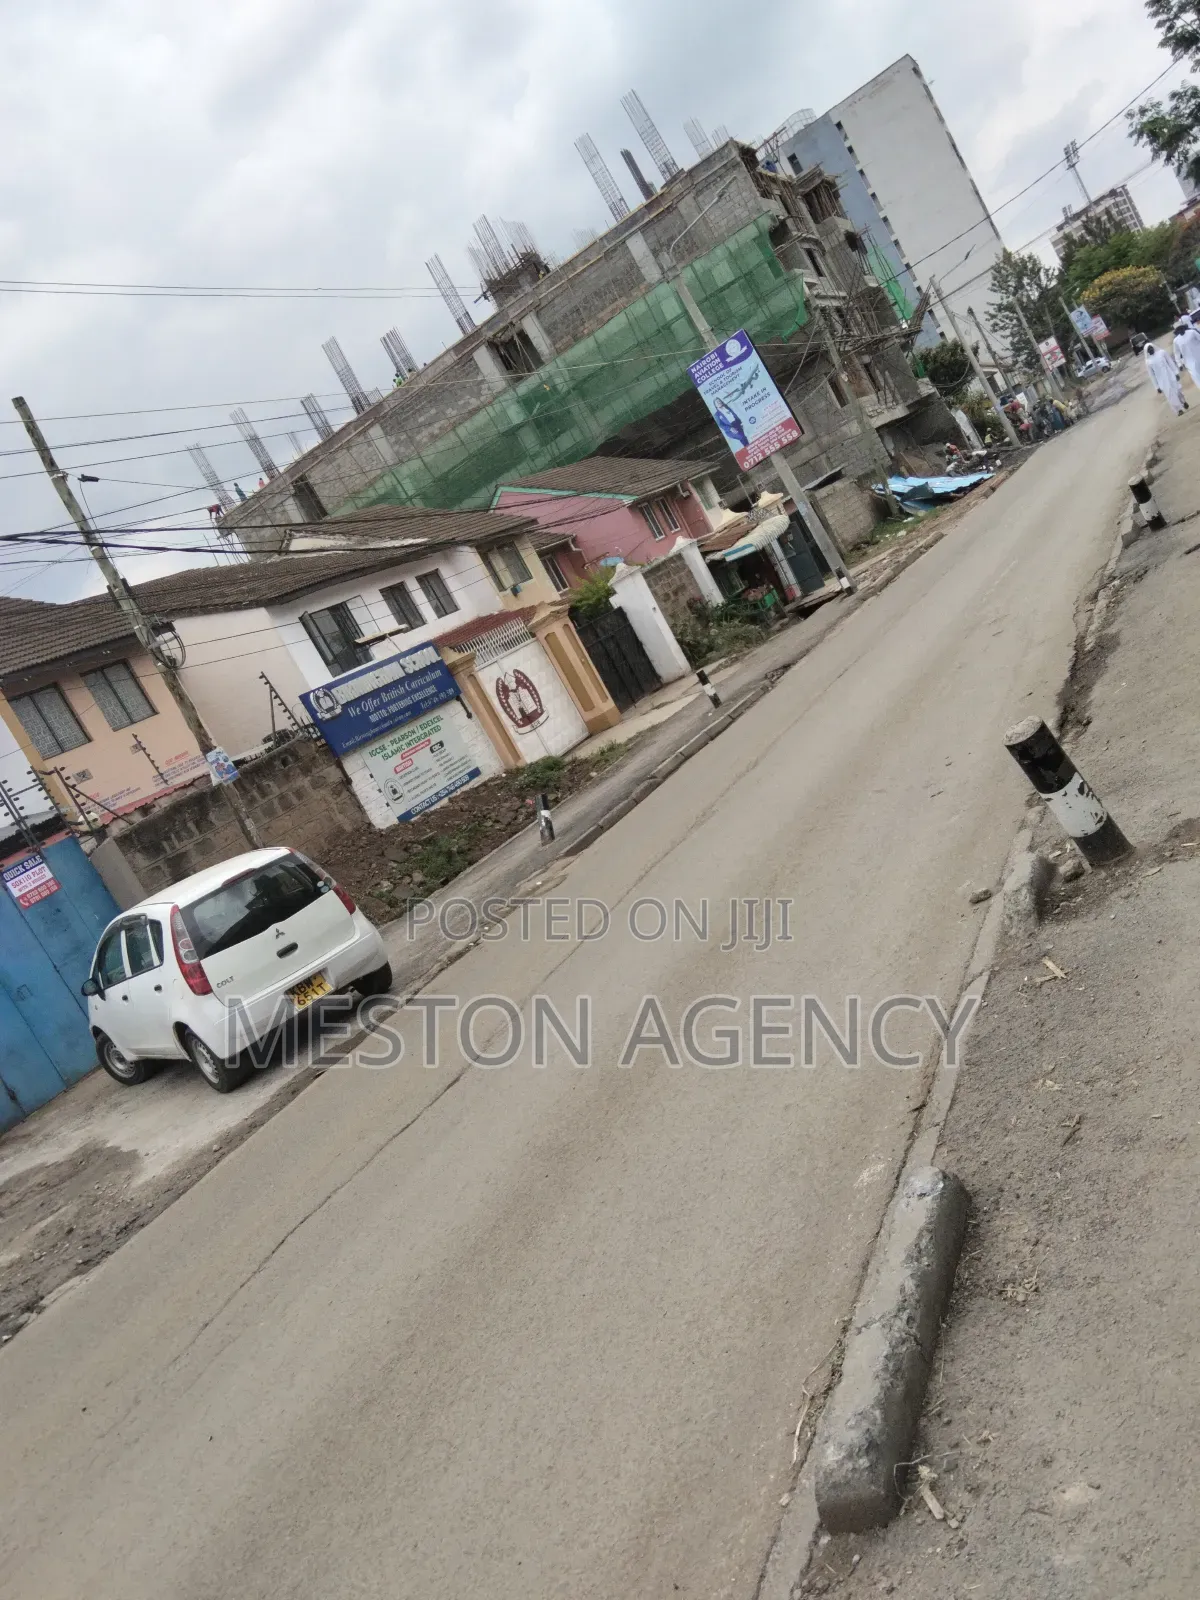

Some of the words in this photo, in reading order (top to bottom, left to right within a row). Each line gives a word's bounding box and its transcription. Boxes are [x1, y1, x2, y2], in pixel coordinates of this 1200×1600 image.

[691, 352, 718, 373] NAIROBI
[694, 358, 721, 379] AVIATION
[696, 363, 724, 384] COLLEGE
[703, 383, 719, 395] TRAVEL
[723, 366, 743, 381] TOURISM
[709, 373, 726, 386] SCHOOL
[711, 374, 740, 396] MANAGEMENT
[742, 390, 761, 406] INTAKE
[744, 392, 771, 412] PROGRESS
[743, 453, 763, 469] 0712
[764, 442, 780, 455] 555
[781, 430, 798, 444] 558
[348, 706, 361, 718] We
[361, 697, 381, 712] Offer
[381, 686, 405, 703] British
[388, 696, 414, 714] FOSTERING
[412, 685, 437, 702] EXCELLENCE
[369, 744, 388, 757] IGCSE
[389, 728, 417, 747] PEARSON
[419, 715, 444, 731] EDEXCEL
[381, 745, 406, 761] ISLAMIC
[405, 725, 442, 749] INTERGRATED
[411, 799, 432, 814] CONTACT
[3, 865, 25, 881] QUICK
[23, 855, 42, 870] SALE
[31, 866, 46, 877] PLOT
[216, 975, 234, 988] COLT
[297, 982, 326, 1006] 651T
